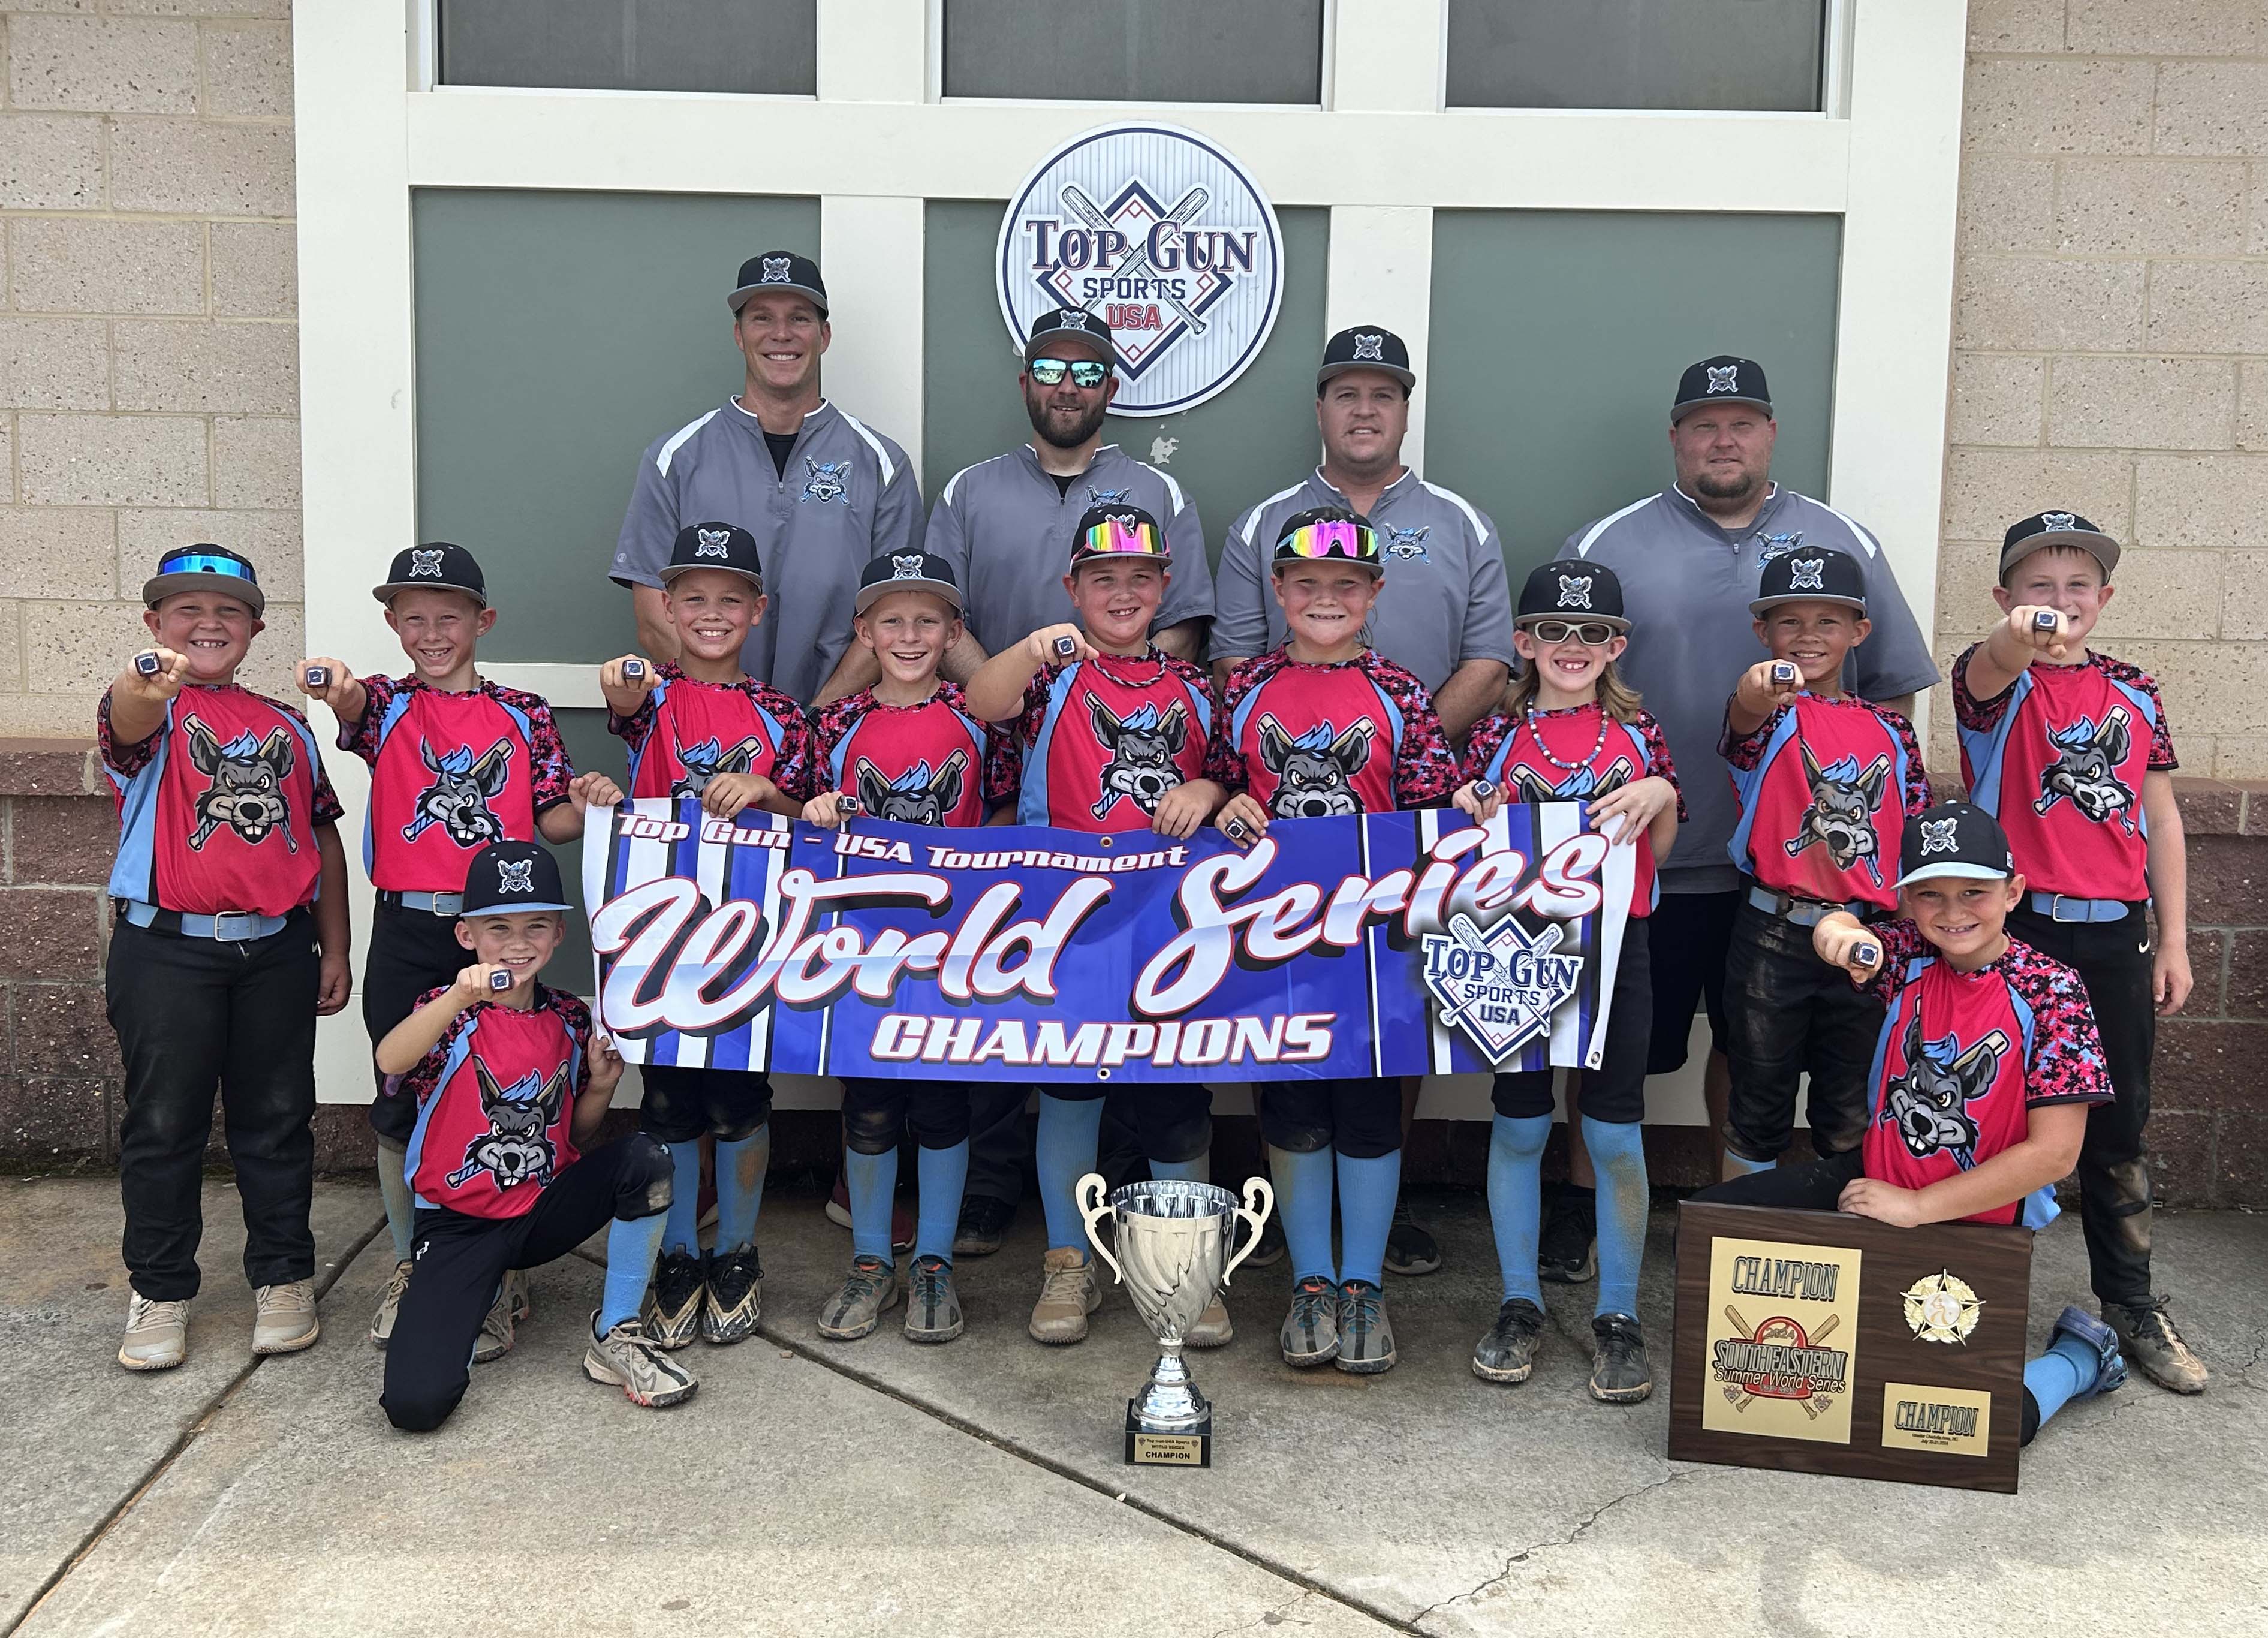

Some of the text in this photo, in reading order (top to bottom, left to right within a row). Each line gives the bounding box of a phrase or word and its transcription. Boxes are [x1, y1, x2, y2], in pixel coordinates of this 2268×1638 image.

[1026, 219, 1257, 272] TOP GUN
[1083, 278, 1186, 299] SPORTS
[1106, 303, 1162, 330] USA
[618, 812, 690, 842] Top
[702, 820, 791, 848] Gun
[833, 832, 913, 863] USA
[926, 845, 1190, 874] Tournament
[592, 827, 1609, 1031] World Series
[1426, 938, 1579, 989] TOP GUN
[1464, 984, 1540, 1005] SPORTS
[1479, 1004, 1520, 1026] USA
[870, 1013, 1336, 1065] CHAMPIONS
[1732, 1256, 1840, 1302] CHAMPION
[1763, 1327, 1795, 1339] 2024
[1712, 1341, 1848, 1380] SOUTHEASTERN
[1715, 1365, 1845, 1393] Summer World Series
[1894, 1401, 1979, 1437] CHAMPION
